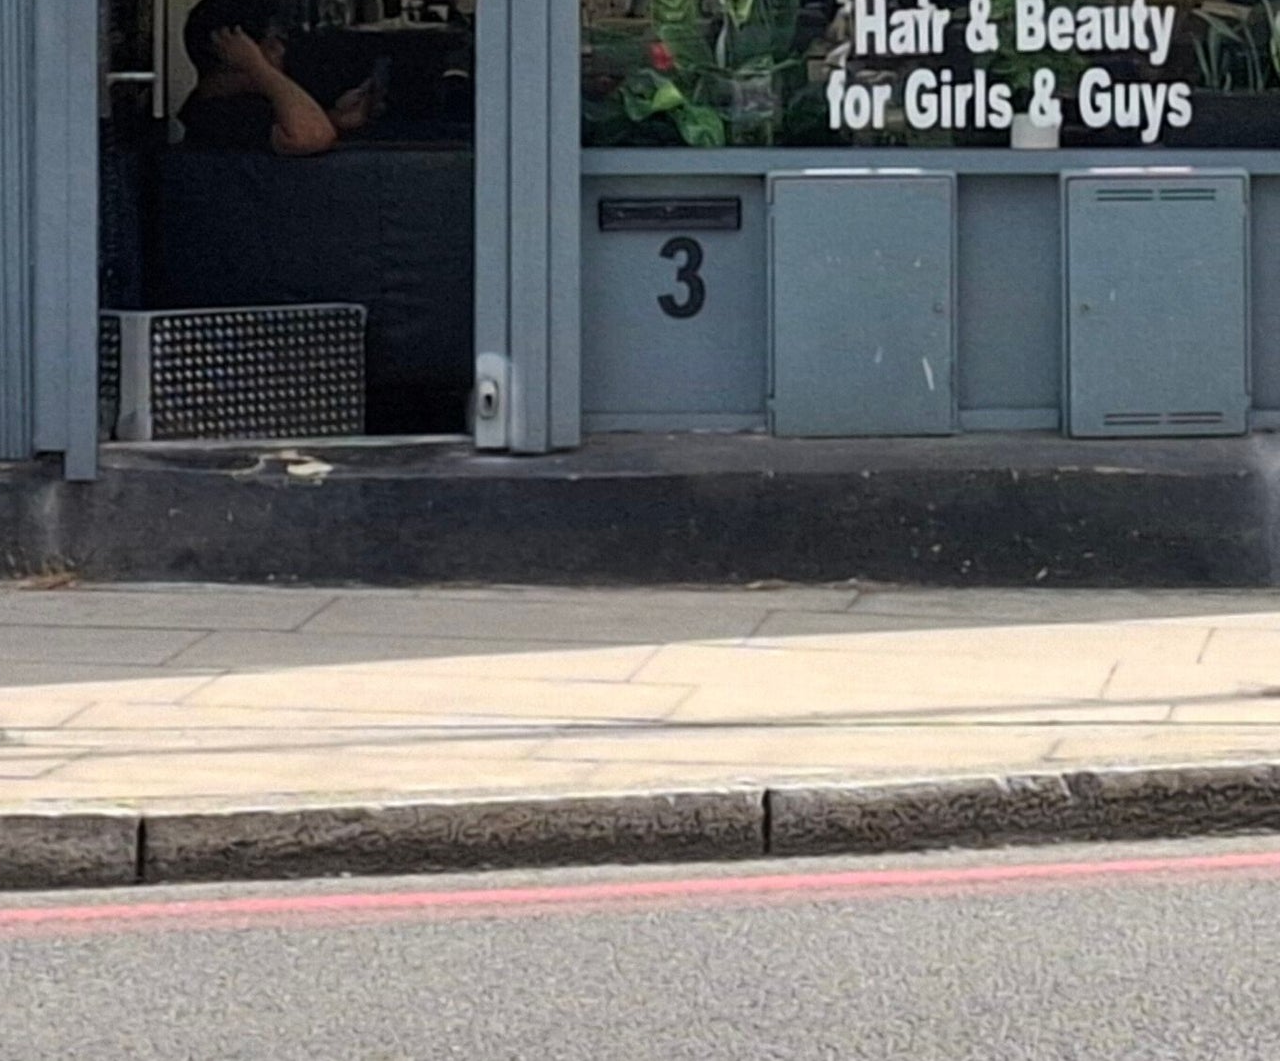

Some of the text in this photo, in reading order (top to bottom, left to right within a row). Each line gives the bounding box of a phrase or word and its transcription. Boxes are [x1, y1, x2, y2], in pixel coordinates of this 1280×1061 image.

[826, 66, 1193, 144] for Girls & Guys
[656, 236, 707, 320] 3
